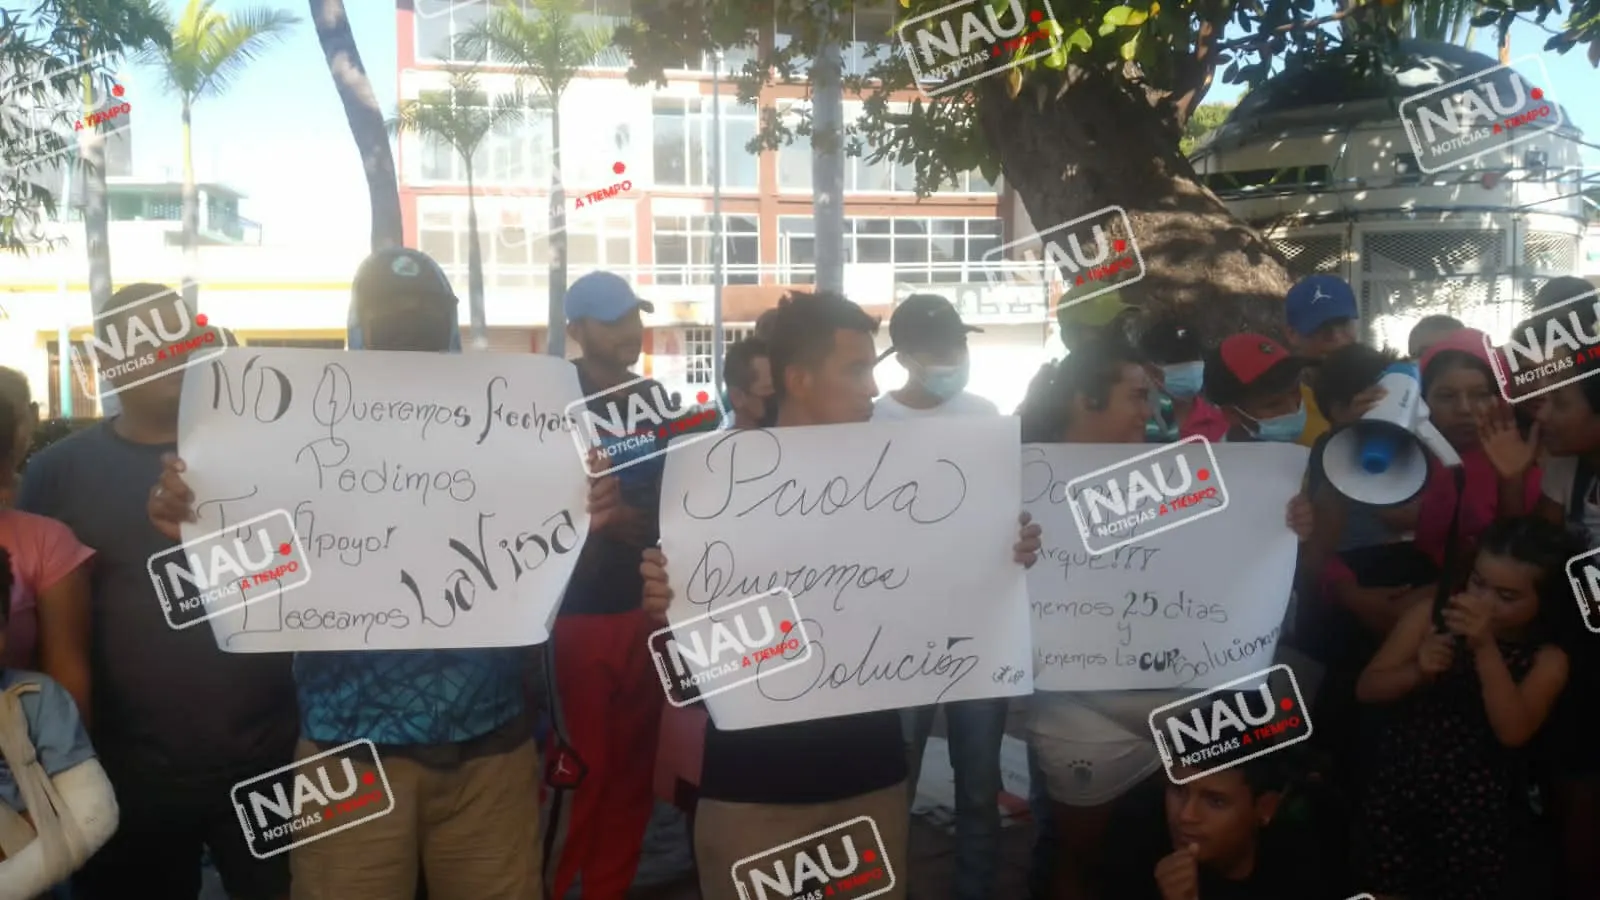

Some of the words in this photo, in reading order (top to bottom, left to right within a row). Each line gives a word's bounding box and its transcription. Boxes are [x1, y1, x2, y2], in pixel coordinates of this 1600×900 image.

[211, 355, 292, 423] NO
[313, 363, 471, 446] Queremos
[296, 437, 475, 505] Pedimos
[683, 428, 966, 523] Paola
[687, 541, 909, 623] Queremos
[1123, 590, 1159, 620] 25
[1118, 620, 1132, 647] y
